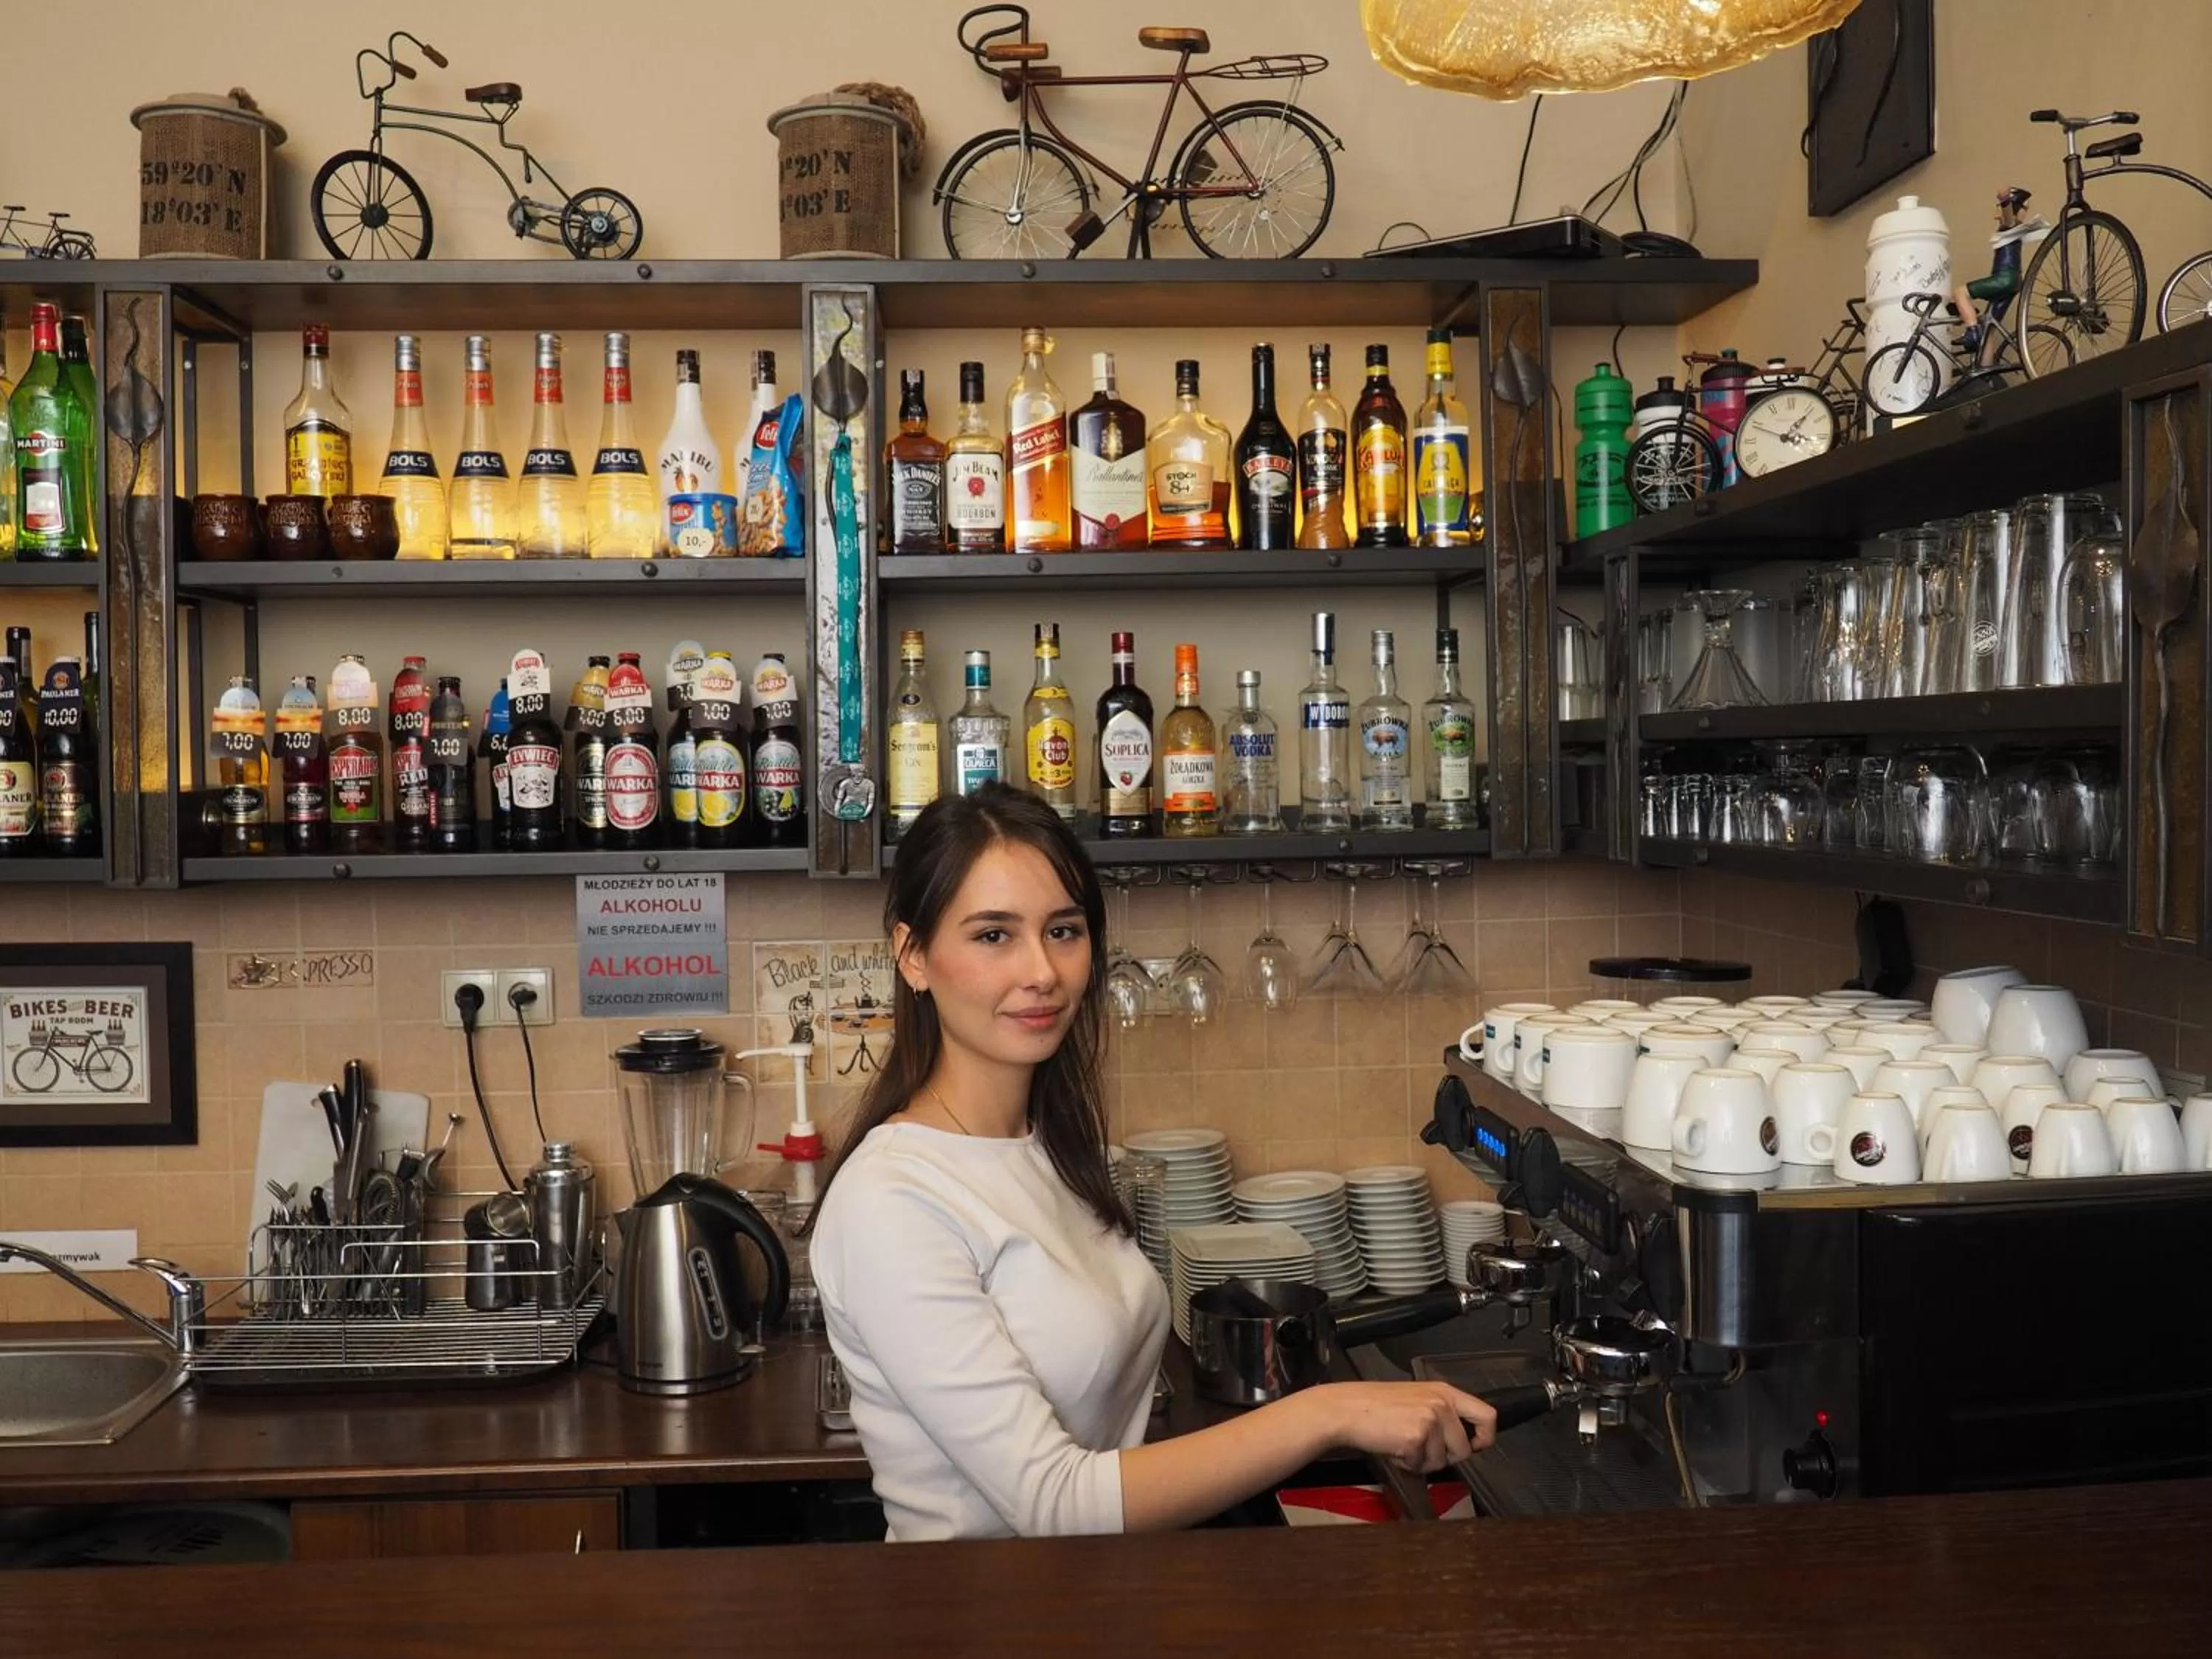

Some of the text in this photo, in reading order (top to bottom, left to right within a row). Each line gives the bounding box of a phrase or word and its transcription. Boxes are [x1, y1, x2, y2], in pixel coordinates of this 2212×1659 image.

[17, 438, 64, 449] MARTINI
[1014, 439, 1032, 454] Red
[1034, 430, 1060, 447] Label
[389, 455, 428, 467] BOLS
[462, 456, 501, 467] BOLS
[528, 453, 566, 465] BOLS
[601, 452, 639, 465] BOLS
[41, 689, 80, 698] PAULANER
[611, 686, 644, 697] WARKA
[1229, 733, 1275, 745] ABSOLUT
[511, 747, 554, 764] ŻYWIEC
[1045, 749, 1067, 761] Club
[1105, 742, 1150, 757] SOPLICA
[1234, 744, 1273, 757] VODKA
[607, 777, 655, 791] WARKA
[756, 771, 801, 785] WARKA
[585, 877, 717, 891] MŁODZIEŻY DO LAT 18
[601, 897, 702, 914] ALKOHOLU
[588, 925, 608, 936] NIE
[611, 923, 701, 936] SPRZEDAJEMY
[587, 955, 722, 978] ALKOHOL
[762, 955, 820, 989] Black
[831, 945, 859, 973] and
[587, 994, 644, 1006] SZKODZI
[647, 992, 709, 1004] ZDROWIU
[10, 999, 135, 1019] BIKES BEER
